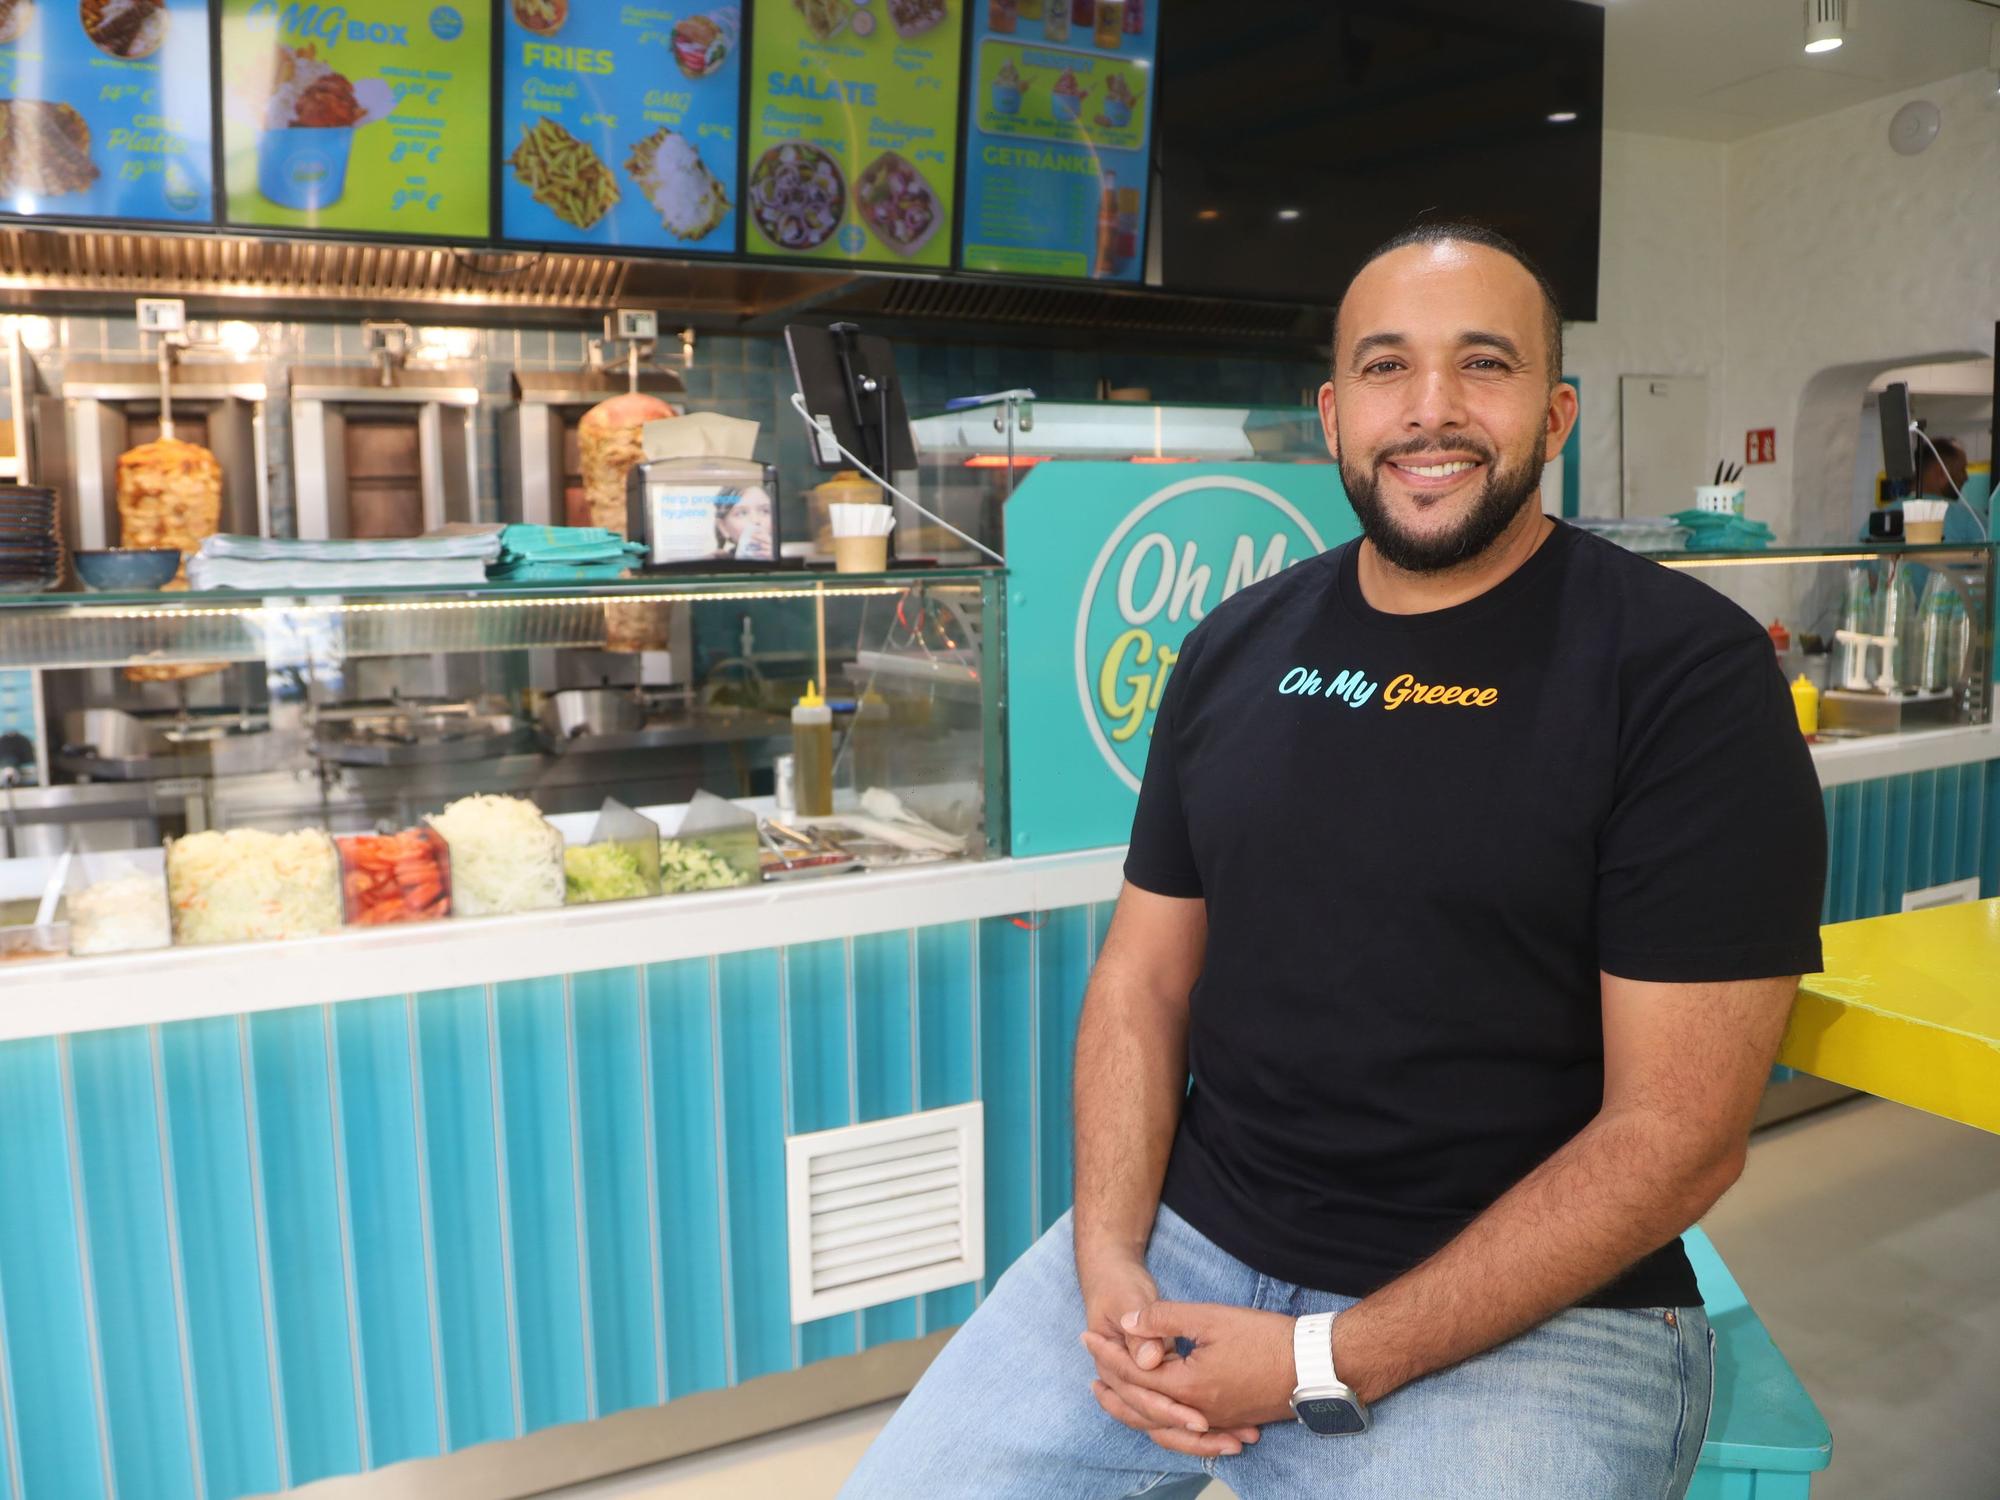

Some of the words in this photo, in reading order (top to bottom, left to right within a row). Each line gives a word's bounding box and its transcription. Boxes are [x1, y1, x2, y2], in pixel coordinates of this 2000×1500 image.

[246, 0, 347, 48] OMG
[347, 20, 409, 47] BOX
[522, 41, 615, 75] FRIES
[768, 71, 879, 107] SALATE
[1117, 532, 1212, 625] Oh
[1221, 532, 1303, 602] M
[1279, 666, 1323, 696] Oh
[1325, 669, 1378, 708] My
[1383, 673, 1498, 711] Greece
